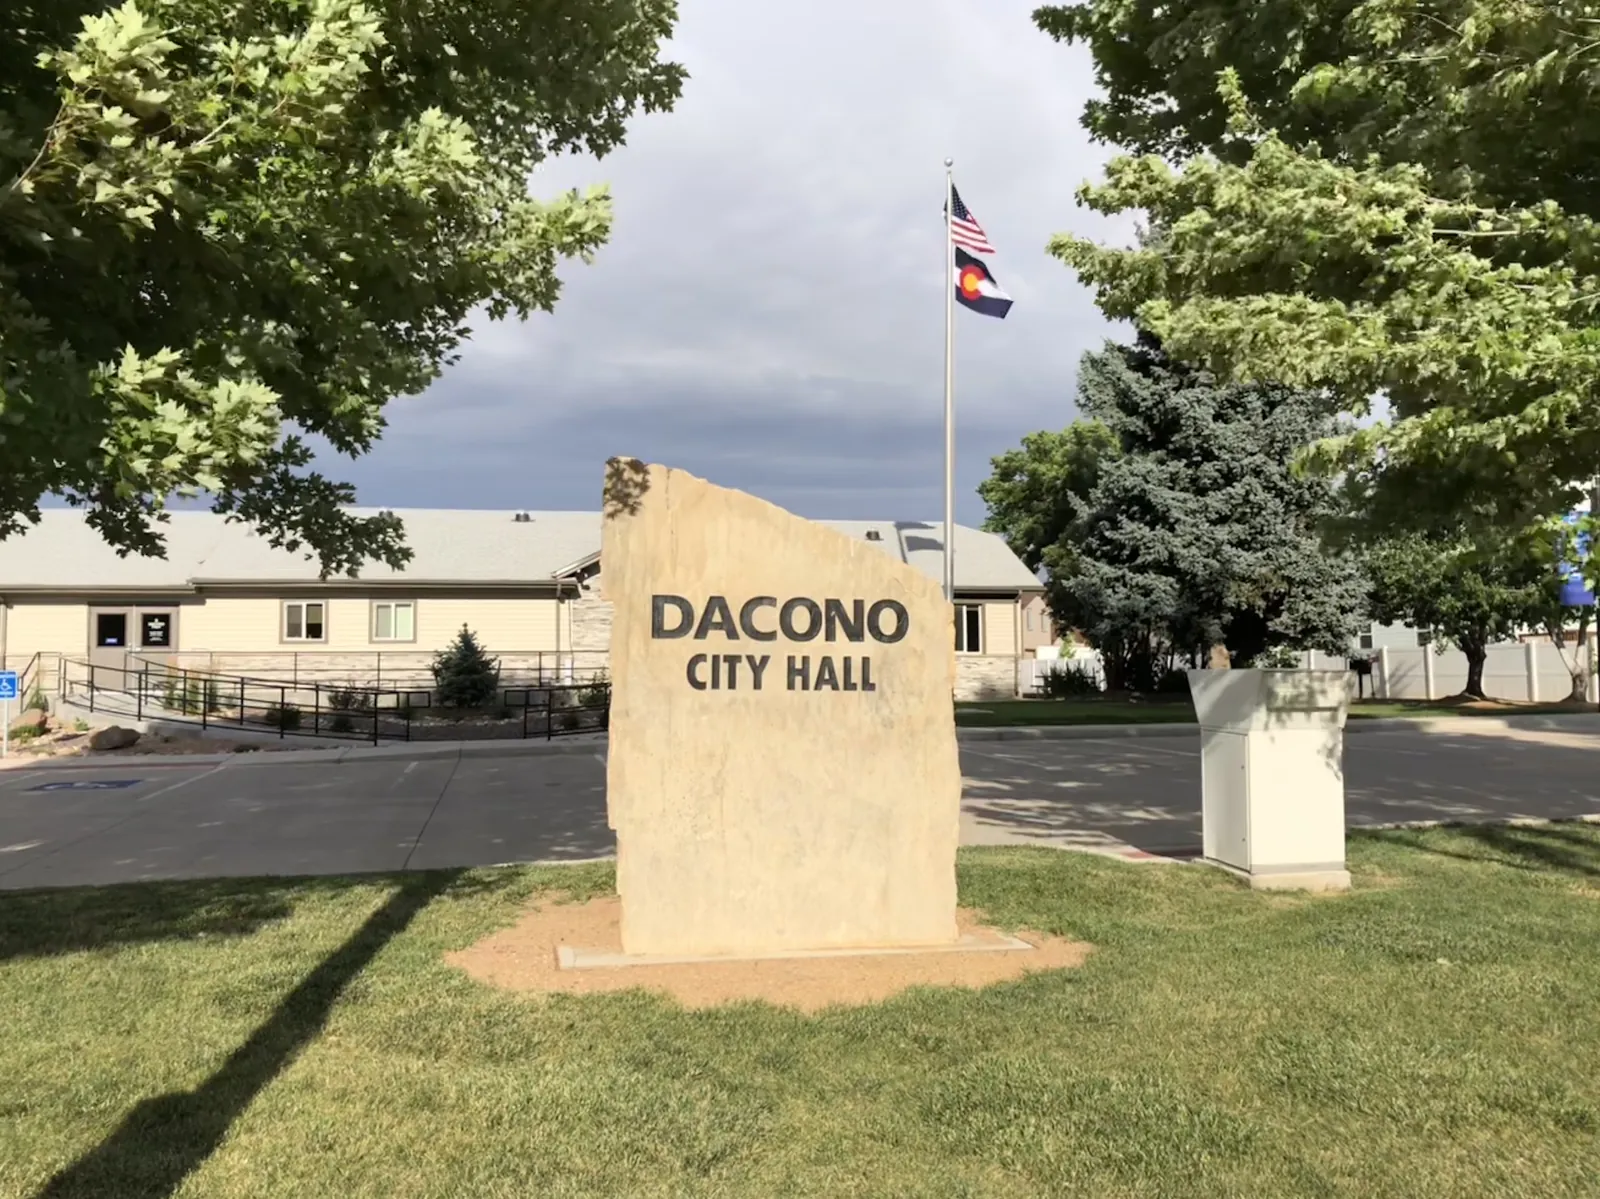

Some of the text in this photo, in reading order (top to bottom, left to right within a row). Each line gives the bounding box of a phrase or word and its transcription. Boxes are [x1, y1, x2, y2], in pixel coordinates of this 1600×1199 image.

[651, 595, 909, 644] DACONO
[686, 653, 876, 691] CITY HALL
